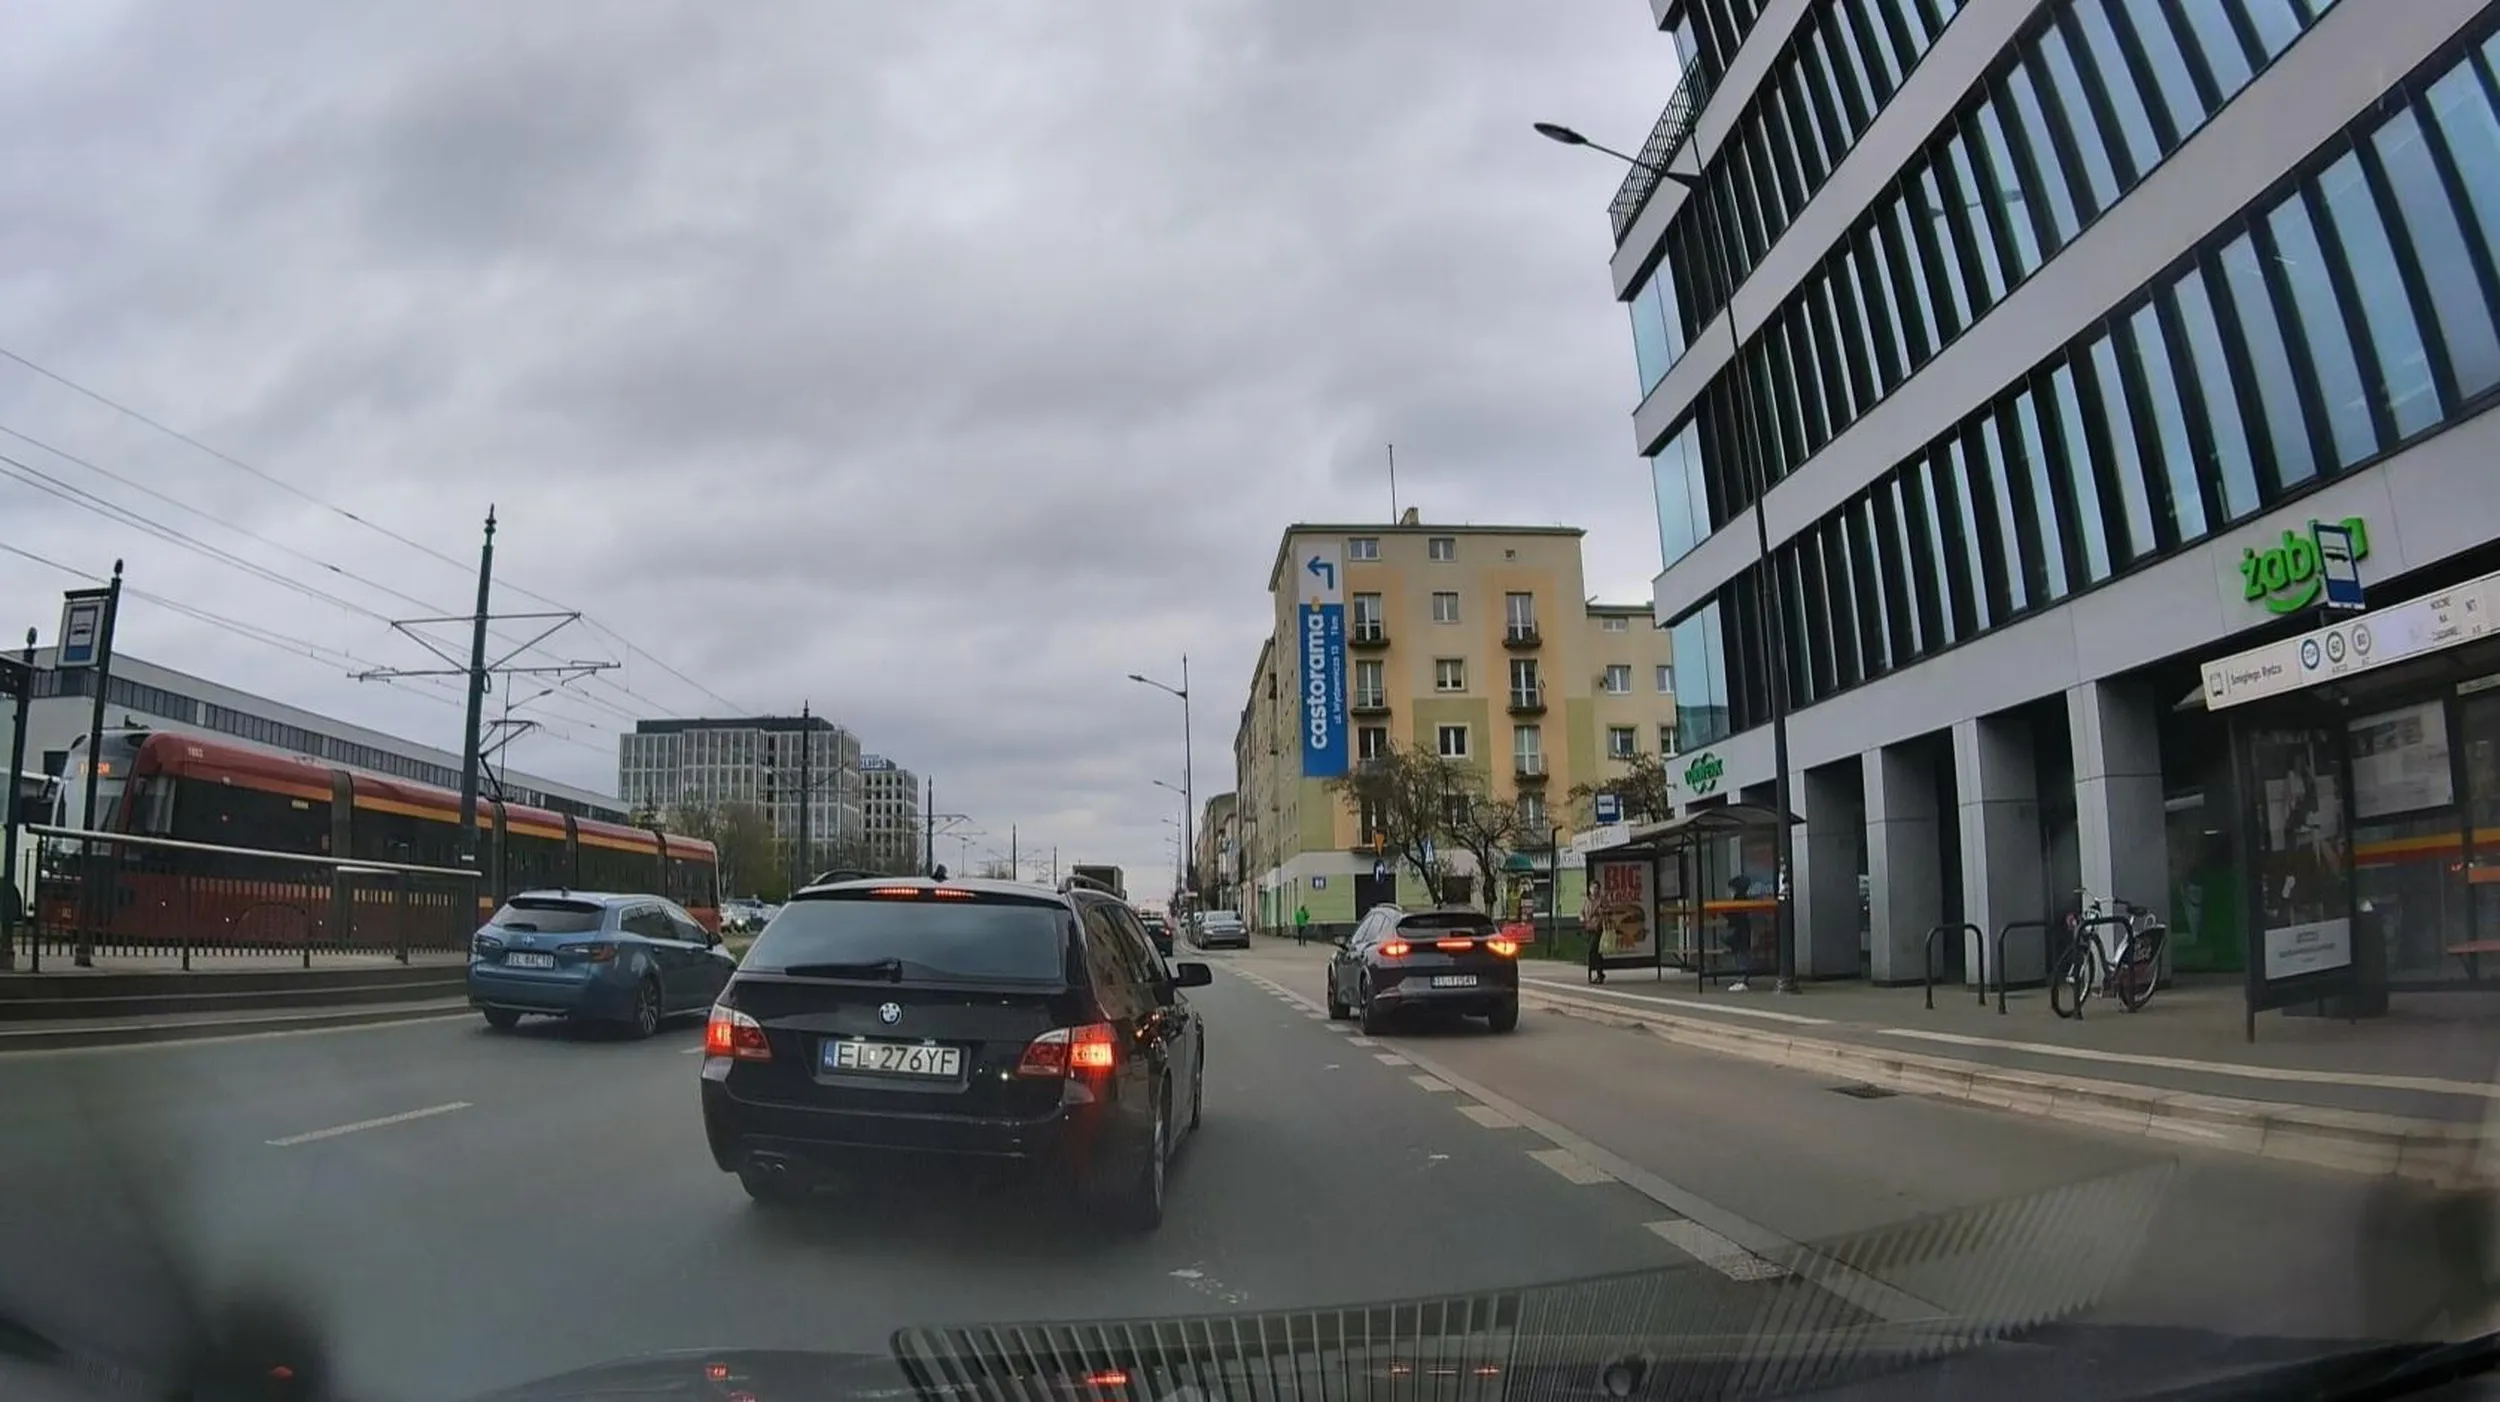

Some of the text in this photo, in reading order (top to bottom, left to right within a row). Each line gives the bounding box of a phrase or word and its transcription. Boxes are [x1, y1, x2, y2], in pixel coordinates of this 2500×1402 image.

[1307, 615, 1327, 750] castorama
[1604, 865, 1643, 891] BIG
[838, 1044, 870, 1068] EL
[880, 1046, 956, 1073] 276YF
